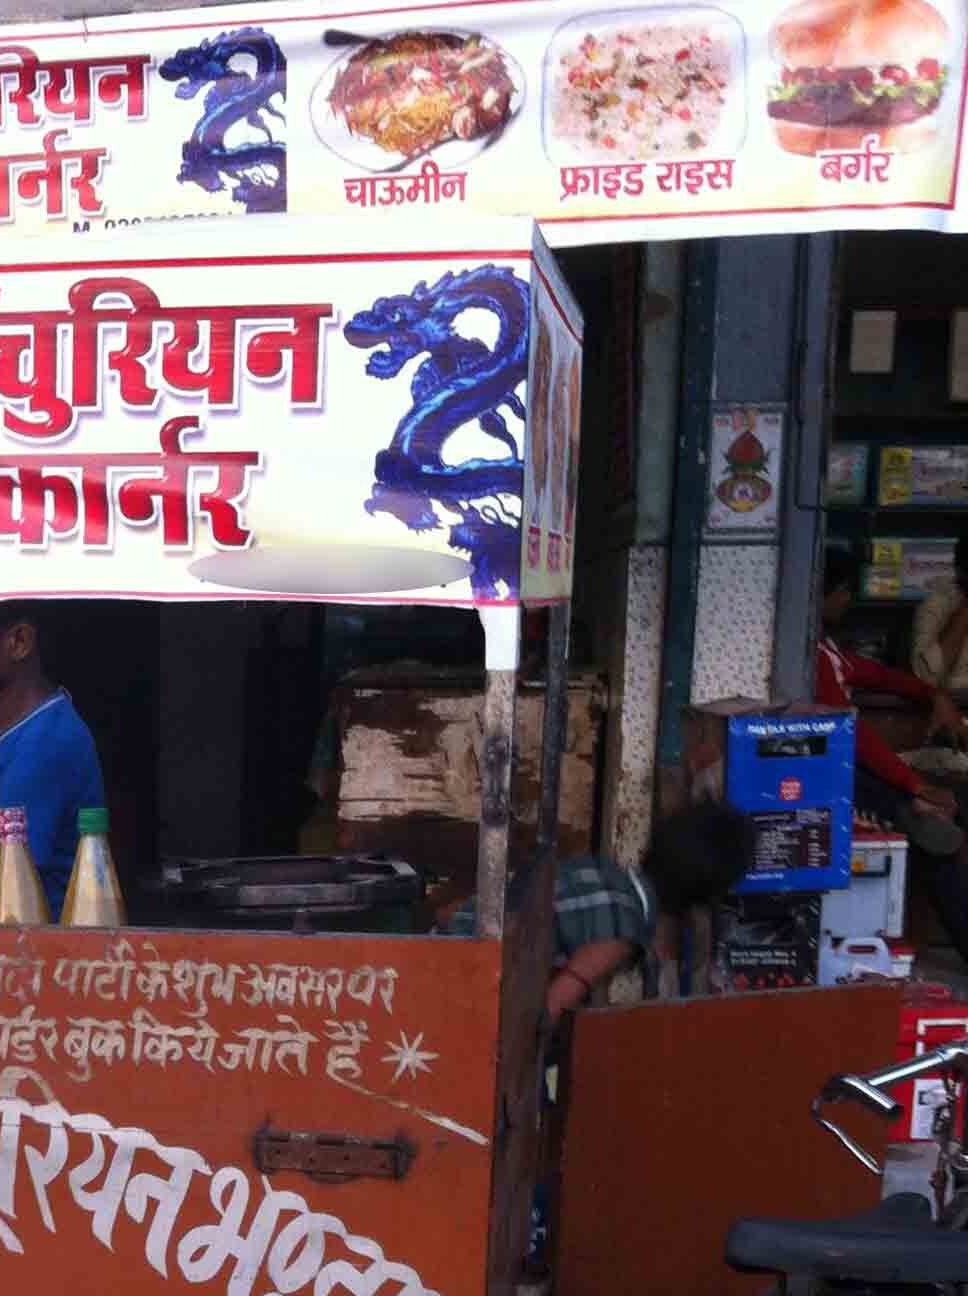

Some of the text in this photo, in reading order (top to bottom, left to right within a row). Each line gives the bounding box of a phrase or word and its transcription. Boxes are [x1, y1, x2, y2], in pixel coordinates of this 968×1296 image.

[560, 158, 737, 201] फ्राइड राइस
[819, 137, 895, 184] बर्गर
[343, 161, 468, 208] चाऊमीन
[62, 1014, 129, 1083] बुक
[220, 1014, 320, 1077] जाते
